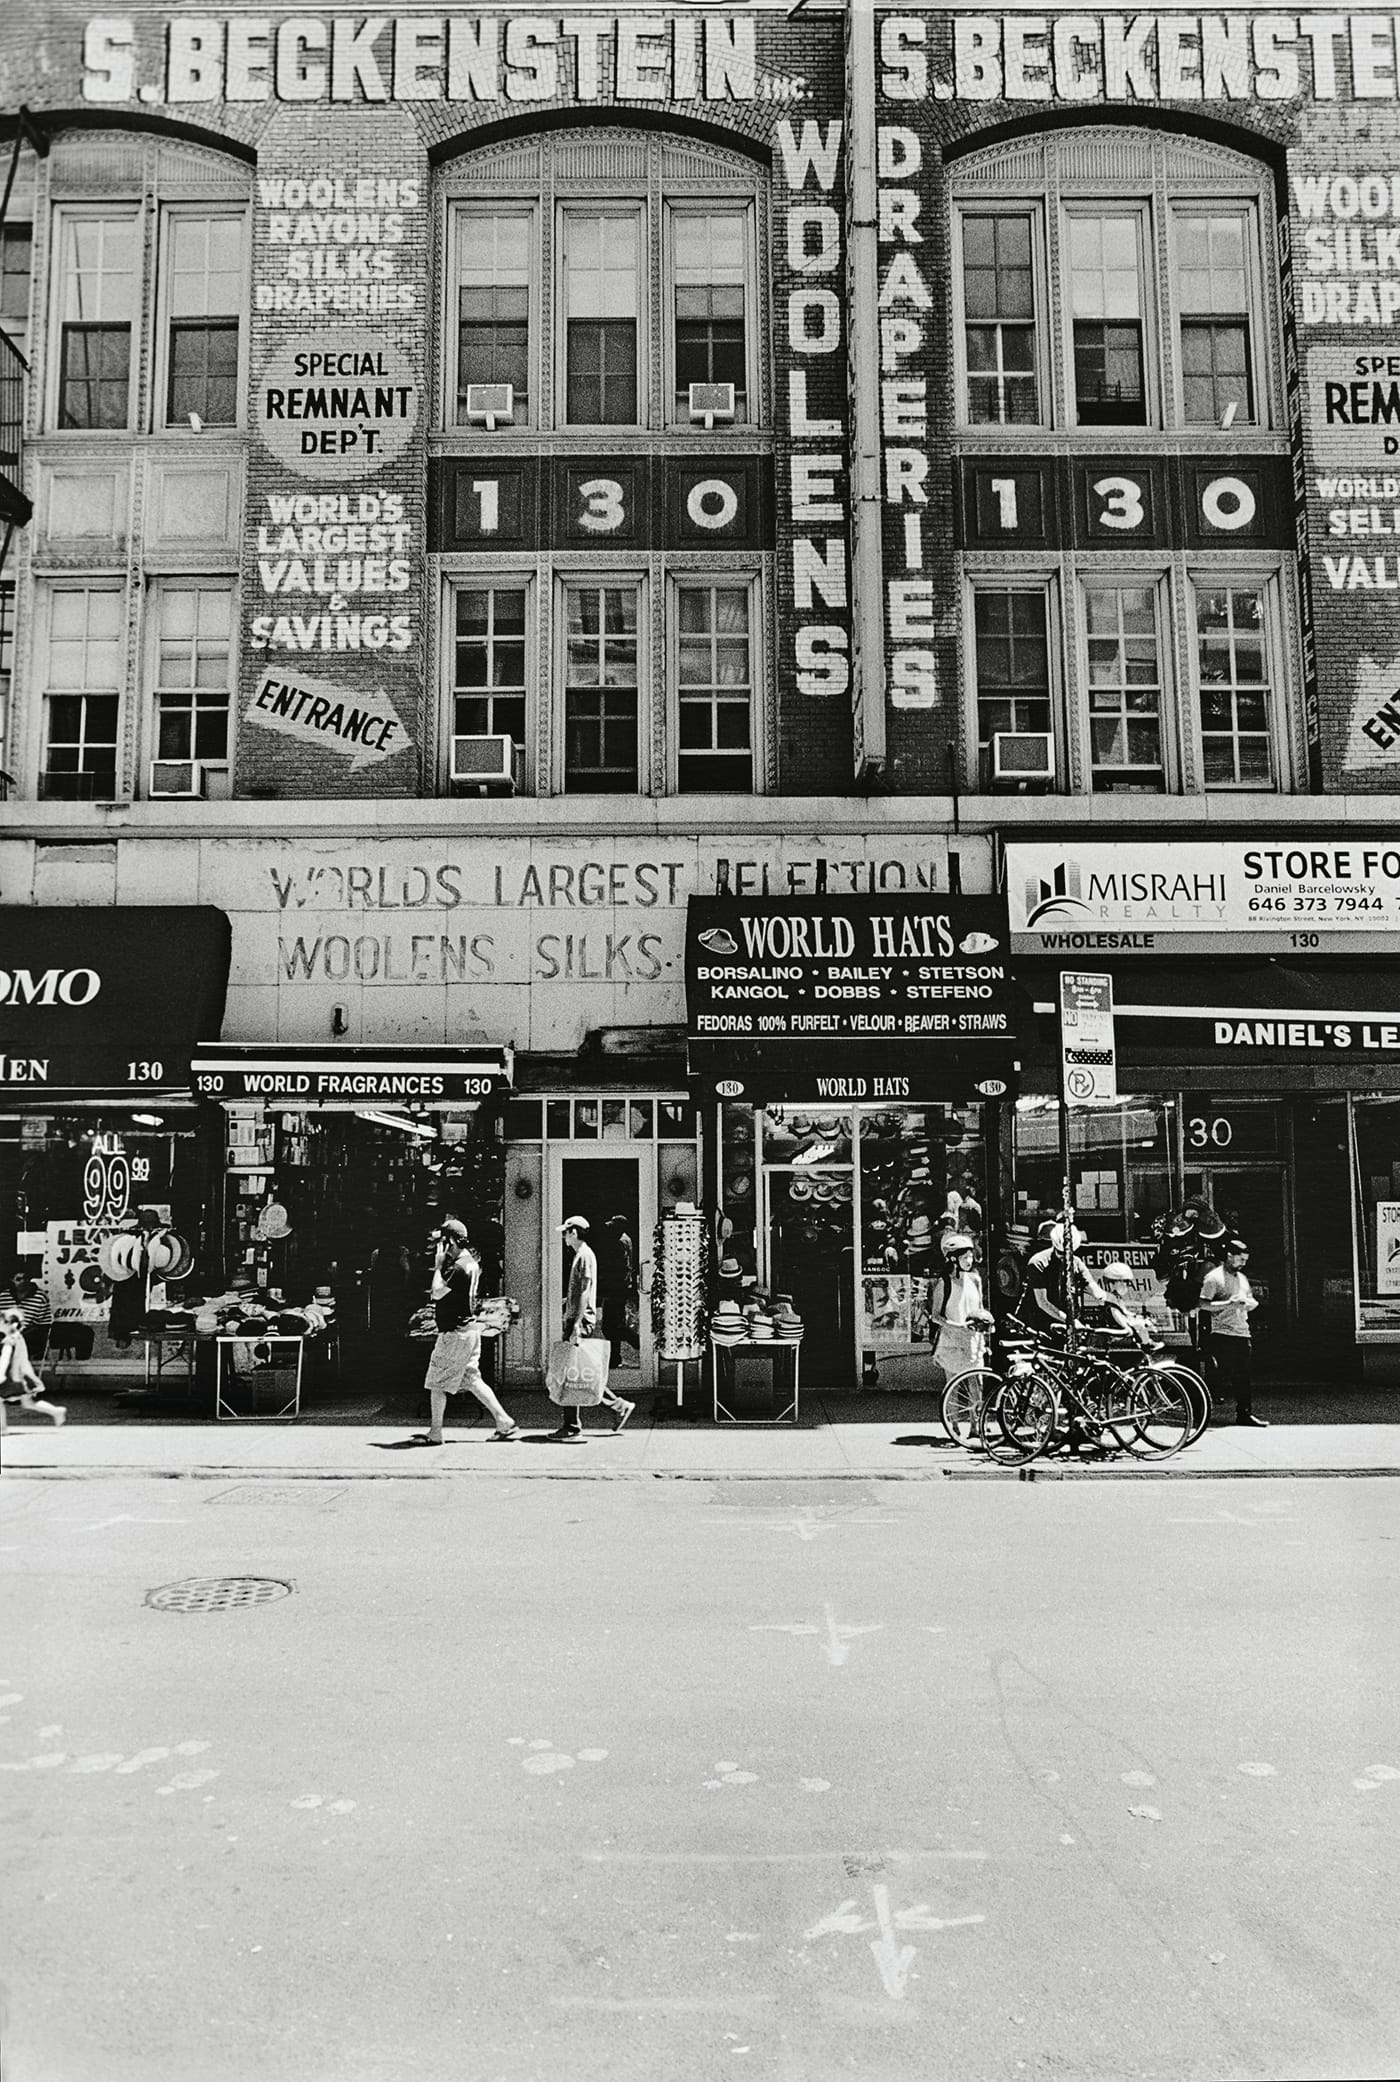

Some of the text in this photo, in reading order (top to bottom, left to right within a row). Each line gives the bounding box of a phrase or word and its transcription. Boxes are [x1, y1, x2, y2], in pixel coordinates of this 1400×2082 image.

[81, 16, 757, 103] S.BECKENSTEIN
[258, 179, 420, 208] WOOLENS
[269, 214, 406, 244] RAYONS
[287, 250, 396, 280] SILKS
[255, 284, 417, 309] DRAPERIES
[294, 352, 389, 377] SPECIAL
[1355, 356, 1400, 377] SPE
[266, 387, 413, 420] REMNANT
[777, 119, 849, 697] WOOLENS
[877, 125, 936, 709] DRAPERIES
[1325, 381, 1400, 425] REM
[300, 424, 384, 455] DEP'T.
[267, 489, 404, 524] WORLD'S
[258, 524, 412, 553] LARGEST
[258, 560, 412, 594] VALUES
[329, 594, 347, 611] &
[250, 616, 413, 650] SAVINGS
[255, 679, 399, 752] ENTRANCE
[1243, 850, 1352, 879] STORE
[494, 863, 685, 907] LARGEST
[1088, 873, 1227, 901] MISRAHI
[1254, 883, 1376, 896] Daniel Barcelowsky
[1099, 904, 1228, 918] REALTY
[1248, 897, 1384, 911] 646 373 7944
[740, 914, 955, 959] WORLD HATS
[1040, 933, 1155, 949] WHOLESALE
[1289, 933, 1320, 948] 130
[278, 933, 663, 980] WOOLENS SILKS
[697, 966, 1005, 981] BORSALINO BAILEY STETSON
[711, 985, 994, 1000] KANGOL DOBBS STEFENO
[697, 1013, 1008, 1033] FEDORAS 100% FURFELT VELOUR BEAVER STRAWS
[1214, 1021, 1400, 1049] DANIEL'S LE
[127, 1061, 164, 1081] 130
[196, 1074, 492, 1095] 130 WORLD FRAGRANCES 130
[720, 1077, 1003, 1098] 130 WORLD HATS 130
[91, 1133, 127, 1155] ALL
[83, 1155, 130, 1219] 99
[1097, 1250, 1119, 1265] FOR
